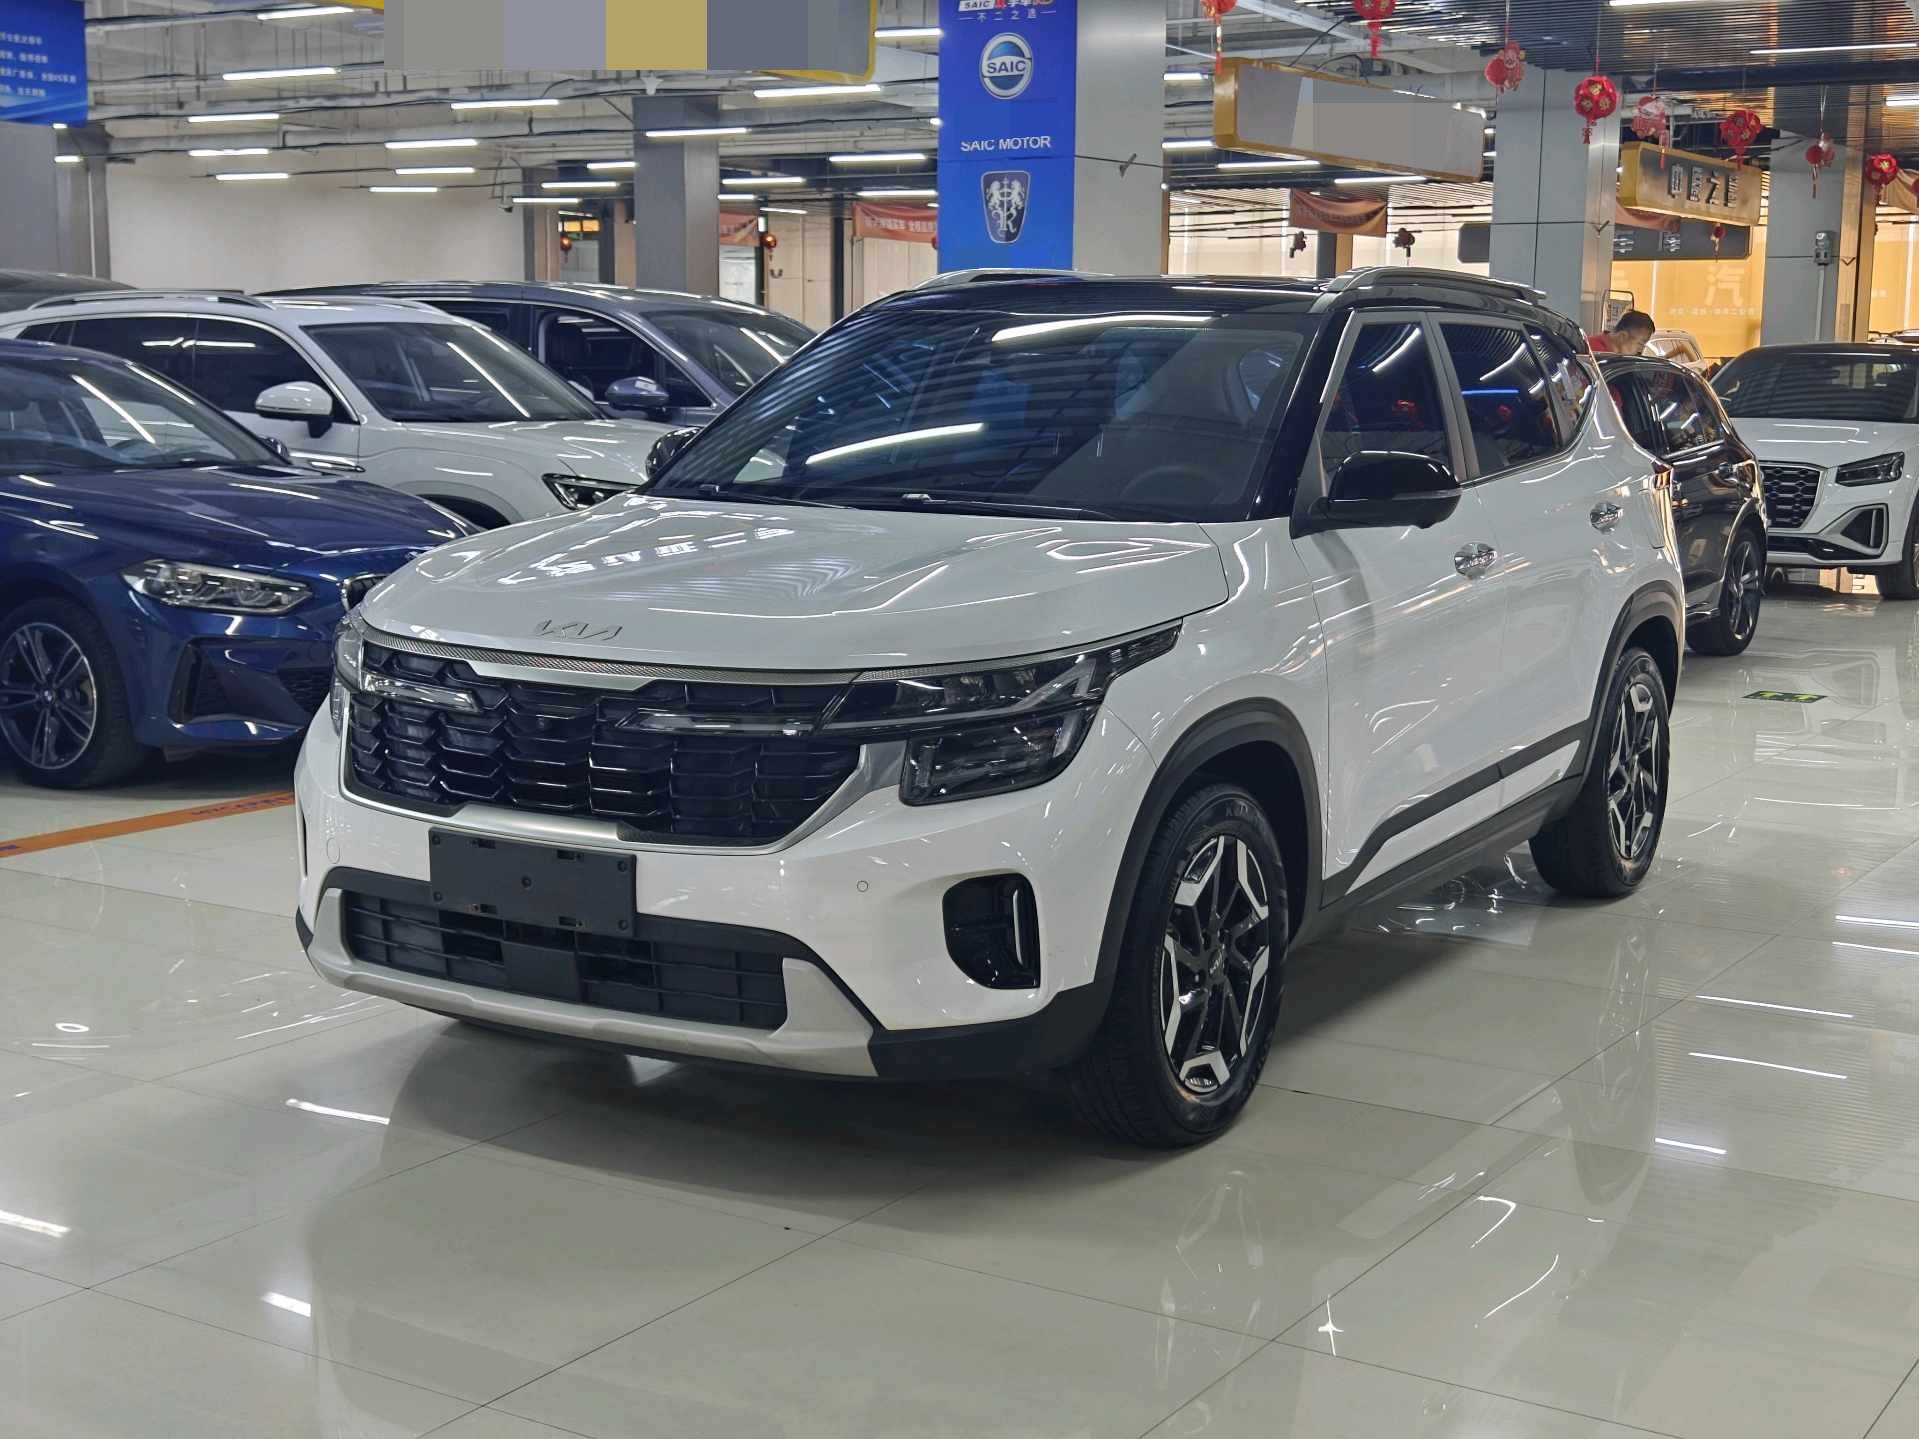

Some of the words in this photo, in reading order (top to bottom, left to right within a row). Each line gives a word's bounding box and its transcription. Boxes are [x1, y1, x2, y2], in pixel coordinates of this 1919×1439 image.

[987, 60, 1026, 74] SAIC
[960, 139, 995, 152] SAIC
[999, 135, 1051, 150] MOTOR
